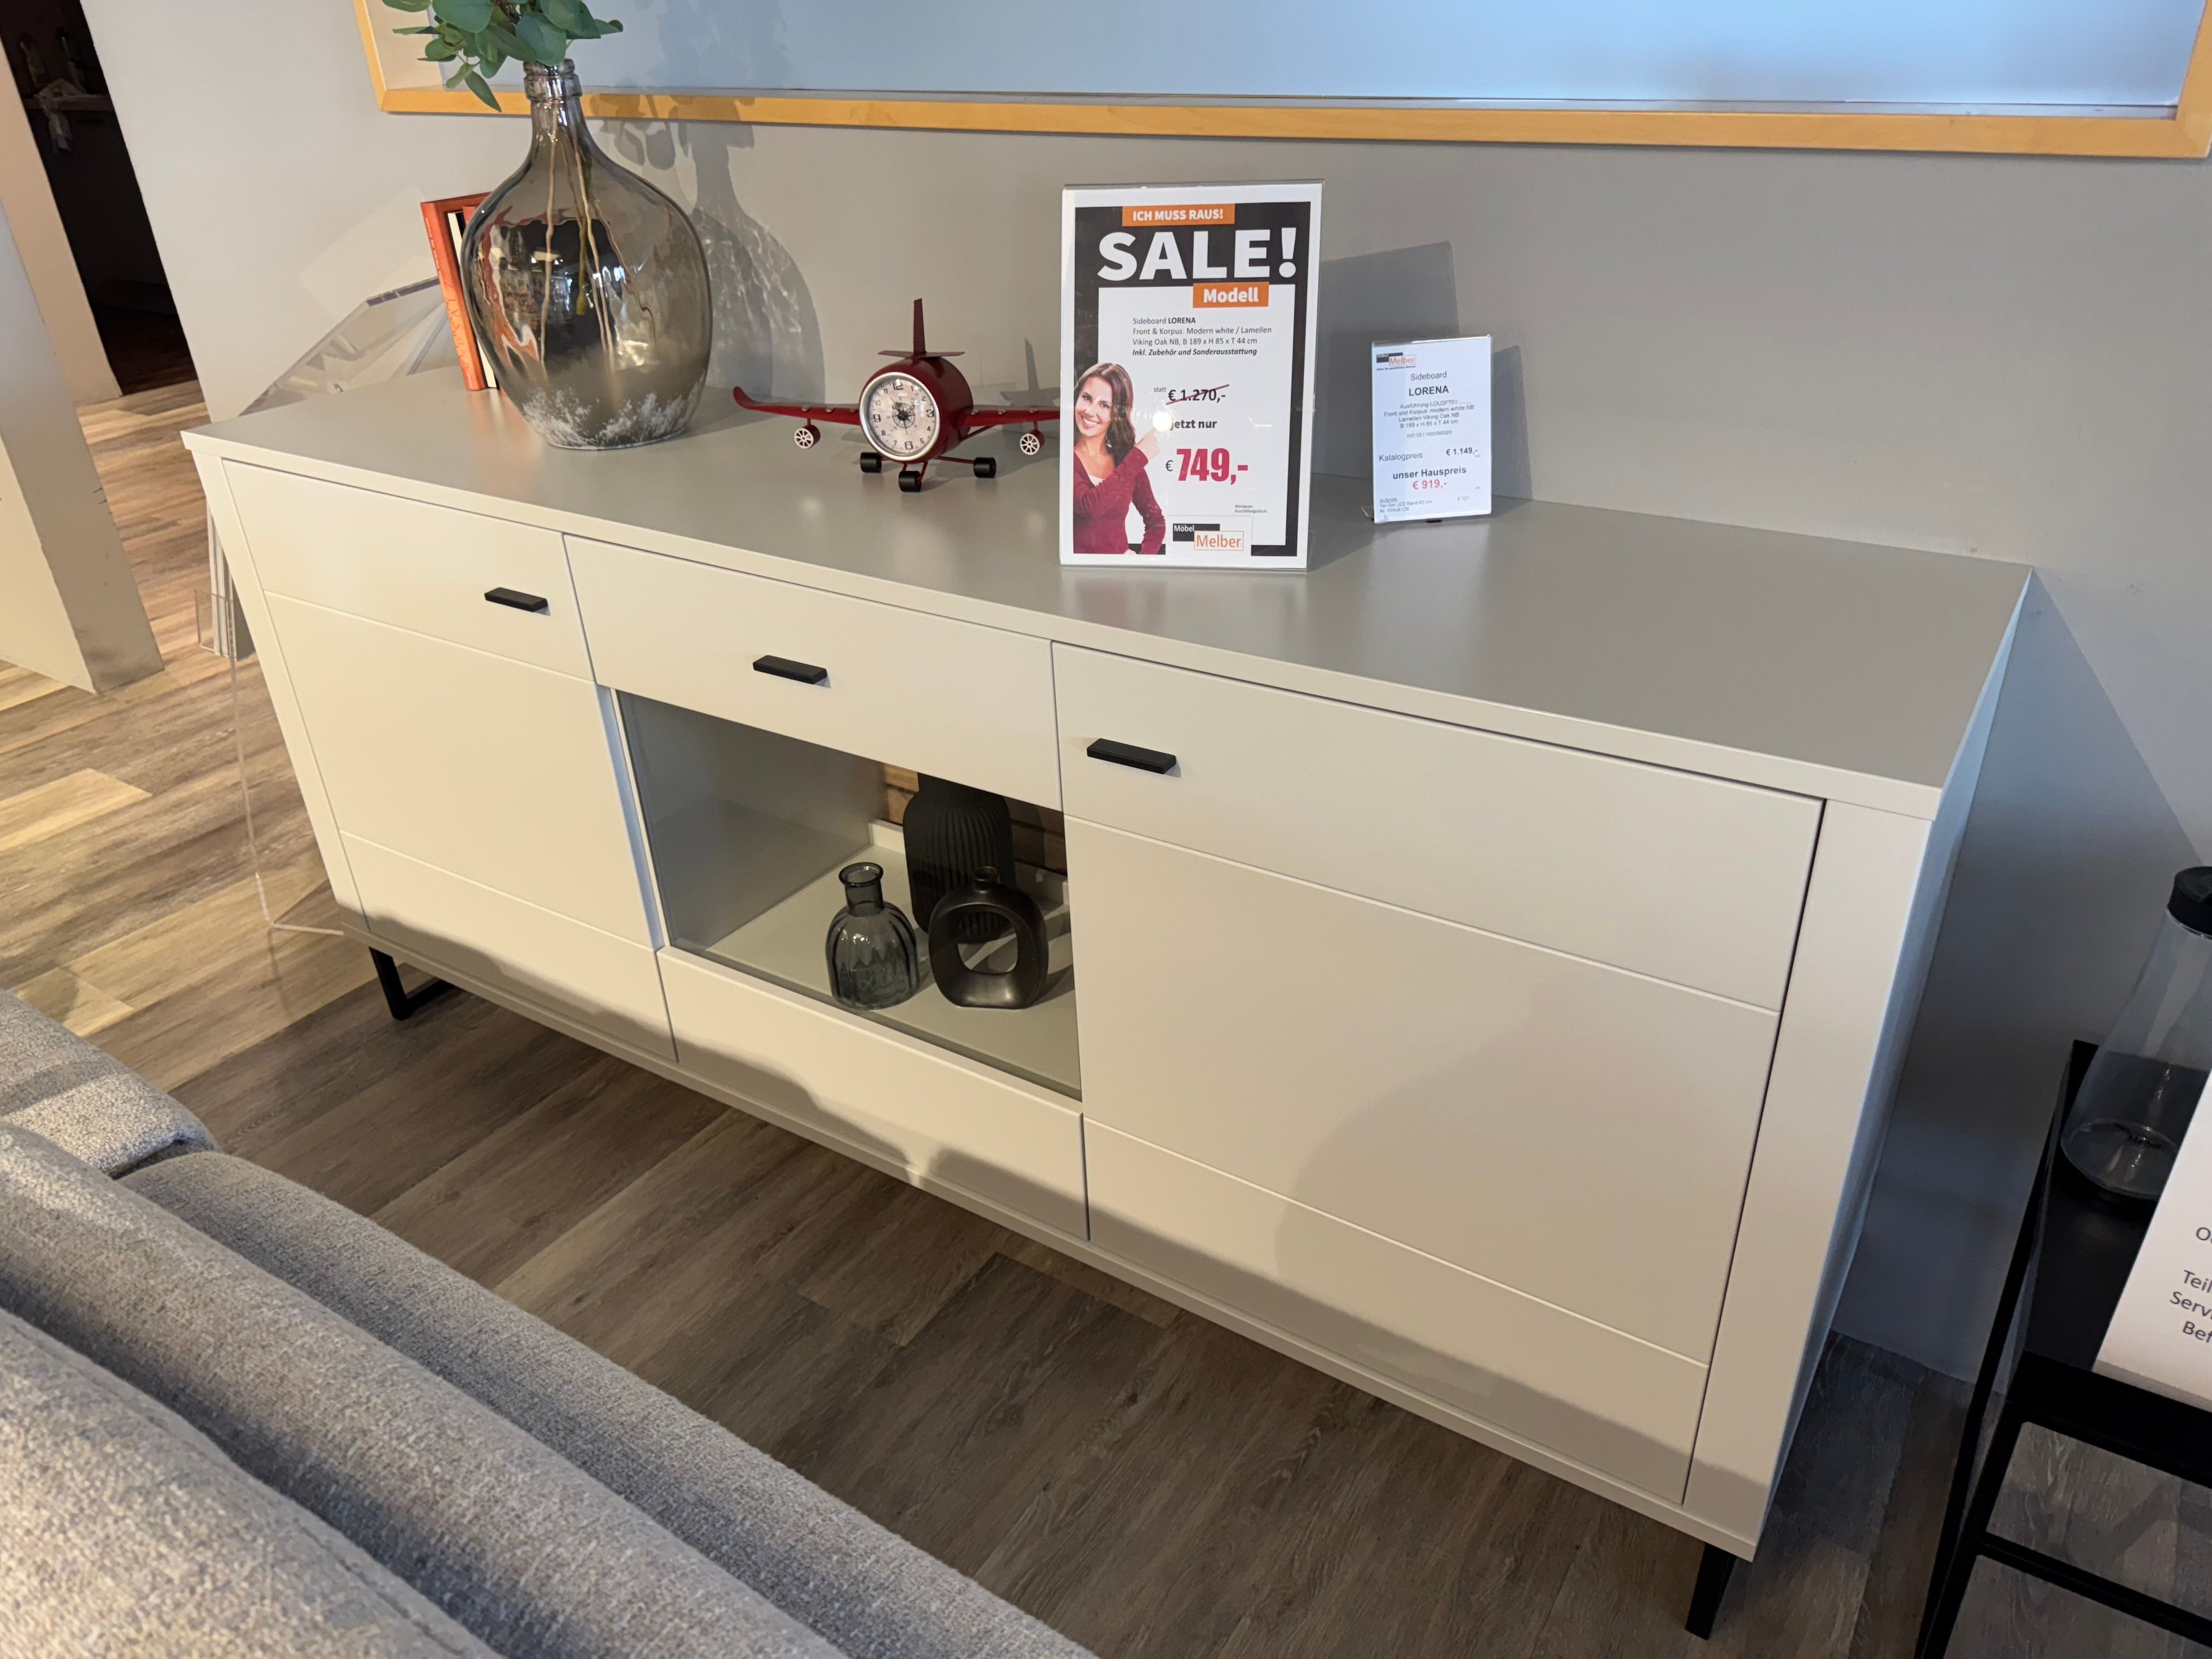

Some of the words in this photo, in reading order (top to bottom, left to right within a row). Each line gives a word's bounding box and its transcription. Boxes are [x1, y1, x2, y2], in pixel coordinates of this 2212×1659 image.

[1132, 210, 1152, 221] ICH
[1155, 210, 1186, 220] MUSS
[1189, 209, 1224, 219] RAUS!
[1097, 228, 1297, 281] SALE!
[1203, 287, 1258, 304] Modell
[1236, 327, 1240, 335] /
[1411, 372, 1447, 381] Sideboard
[893, 382, 904, 390] 12
[1409, 385, 1449, 396] LORENA
[1168, 389, 1176, 402] €
[1180, 388, 1226, 403] 1.270,-
[926, 409, 934, 418] 3
[1169, 418, 1195, 430] jetzt
[1199, 419, 1217, 429] nur
[904, 441, 913, 450] 6
[1379, 452, 1423, 461] Katalogpreis
[1165, 459, 1173, 472] €
[1176, 448, 1248, 485] 749,-
[1393, 471, 1418, 479] unser
[1422, 467, 1466, 478] Hauspreis
[1412, 481, 1418, 489] €
[1422, 479, 1447, 489] 919,-
[1174, 524, 1195, 533] Möbel
[1196, 535, 1241, 548] Melber
